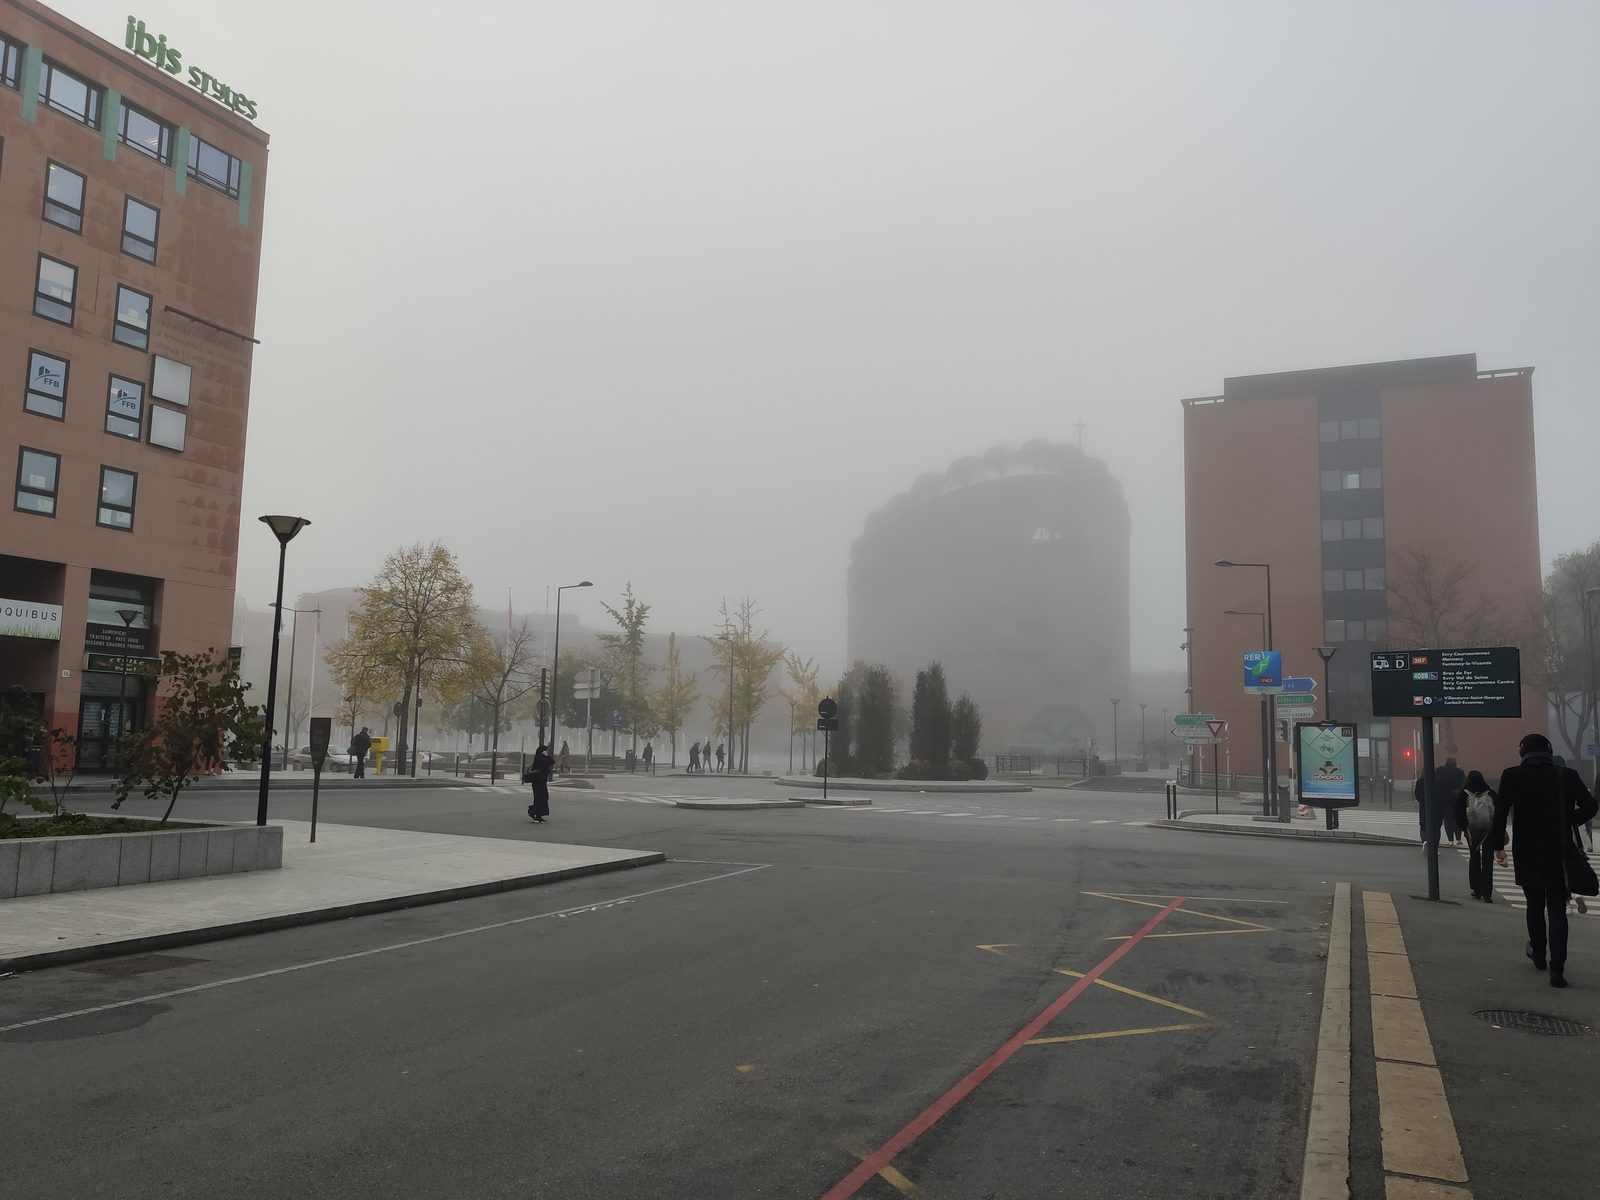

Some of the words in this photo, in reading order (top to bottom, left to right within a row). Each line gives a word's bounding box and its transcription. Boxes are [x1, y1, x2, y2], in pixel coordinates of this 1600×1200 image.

[125, 15, 182, 75] ibis
[44, 377, 60, 388] FFB
[121, 400, 136, 410] FFB
[1244, 653, 1261, 662] RER
[1395, 659, 1404, 669] D
